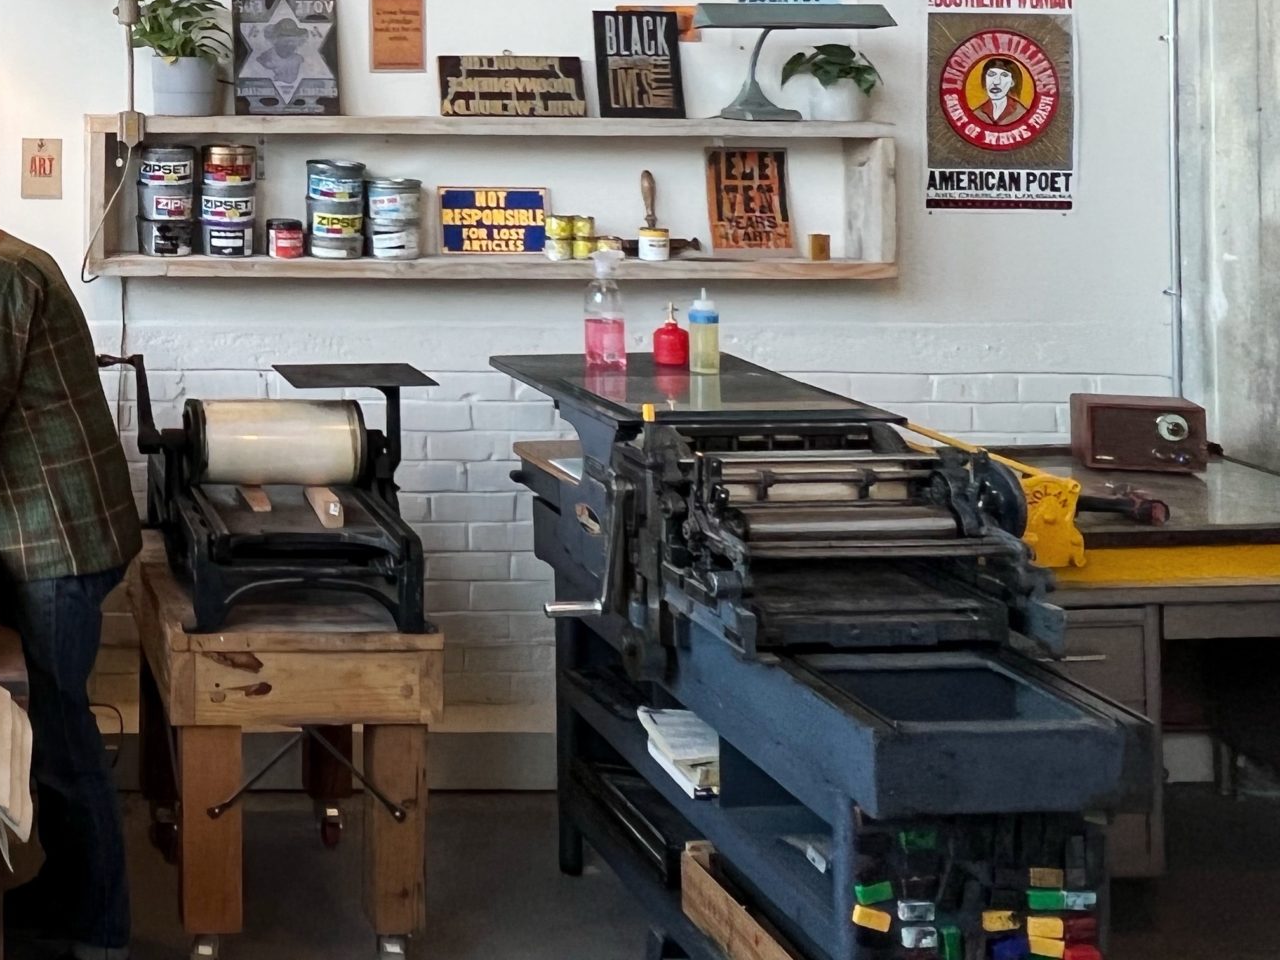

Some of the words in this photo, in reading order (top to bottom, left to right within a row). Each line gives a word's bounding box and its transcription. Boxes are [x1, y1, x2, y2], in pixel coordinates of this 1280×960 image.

[605, 15, 670, 55] BLACK
[608, 69, 652, 108] LIVES
[965, 124, 981, 138] OF
[984, 125, 1031, 145] WHITE
[1029, 96, 1054, 129] TRASH
[30, 155, 54, 177] ART
[141, 162, 188, 174] ZIPSET
[927, 170, 1021, 191] AMERICAN
[1026, 172, 1073, 192] POET
[204, 200, 249, 210] ZIPSET
[475, 192, 507, 208] NOT
[442, 209, 544, 225] RESPONSIBLE
[462, 228, 487, 239] FOR
[493, 228, 525, 240] LOST
[463, 240, 524, 251] ARTICLES
[1028, 484, 1068, 508] NOLAN
